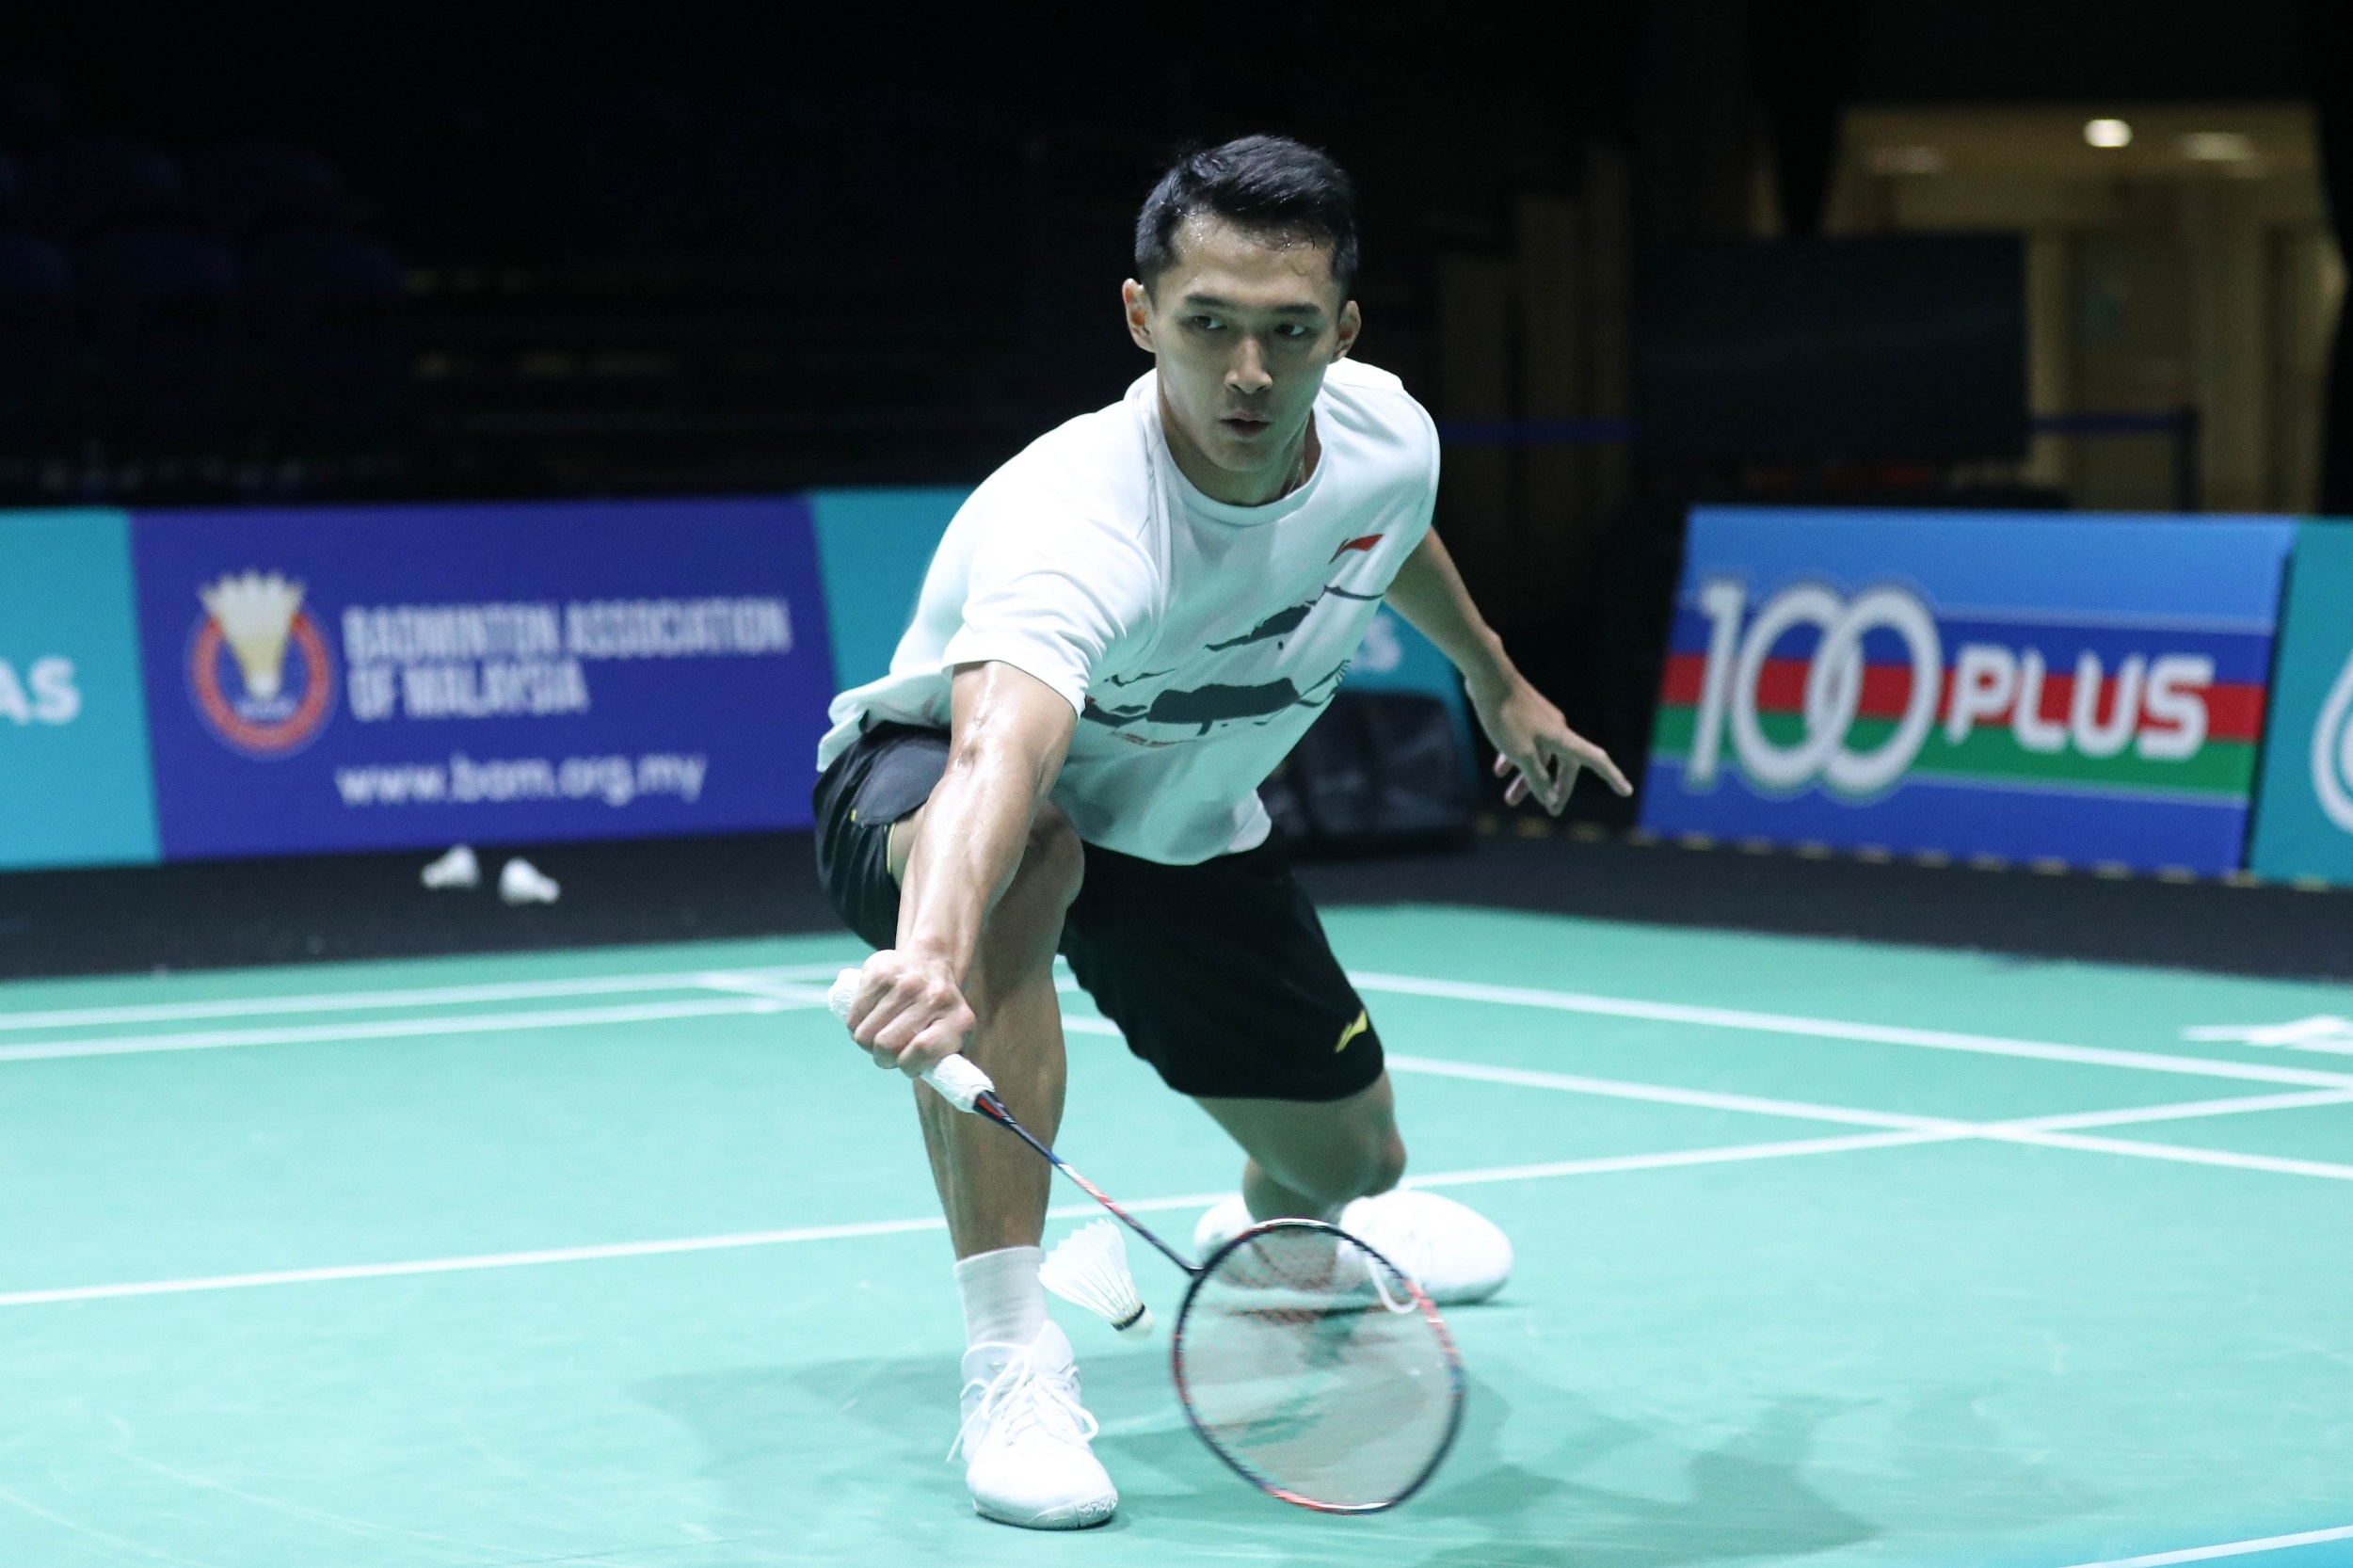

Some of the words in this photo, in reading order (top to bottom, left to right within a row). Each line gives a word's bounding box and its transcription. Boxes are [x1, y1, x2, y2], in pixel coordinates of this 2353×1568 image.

[342, 604, 561, 660] BADMINTON
[565, 596, 792, 657] ASSOCIATION
[347, 662, 396, 721] OF
[401, 658, 590, 719] MALAYSIA
[335, 754, 707, 808] www.bam.org.my
